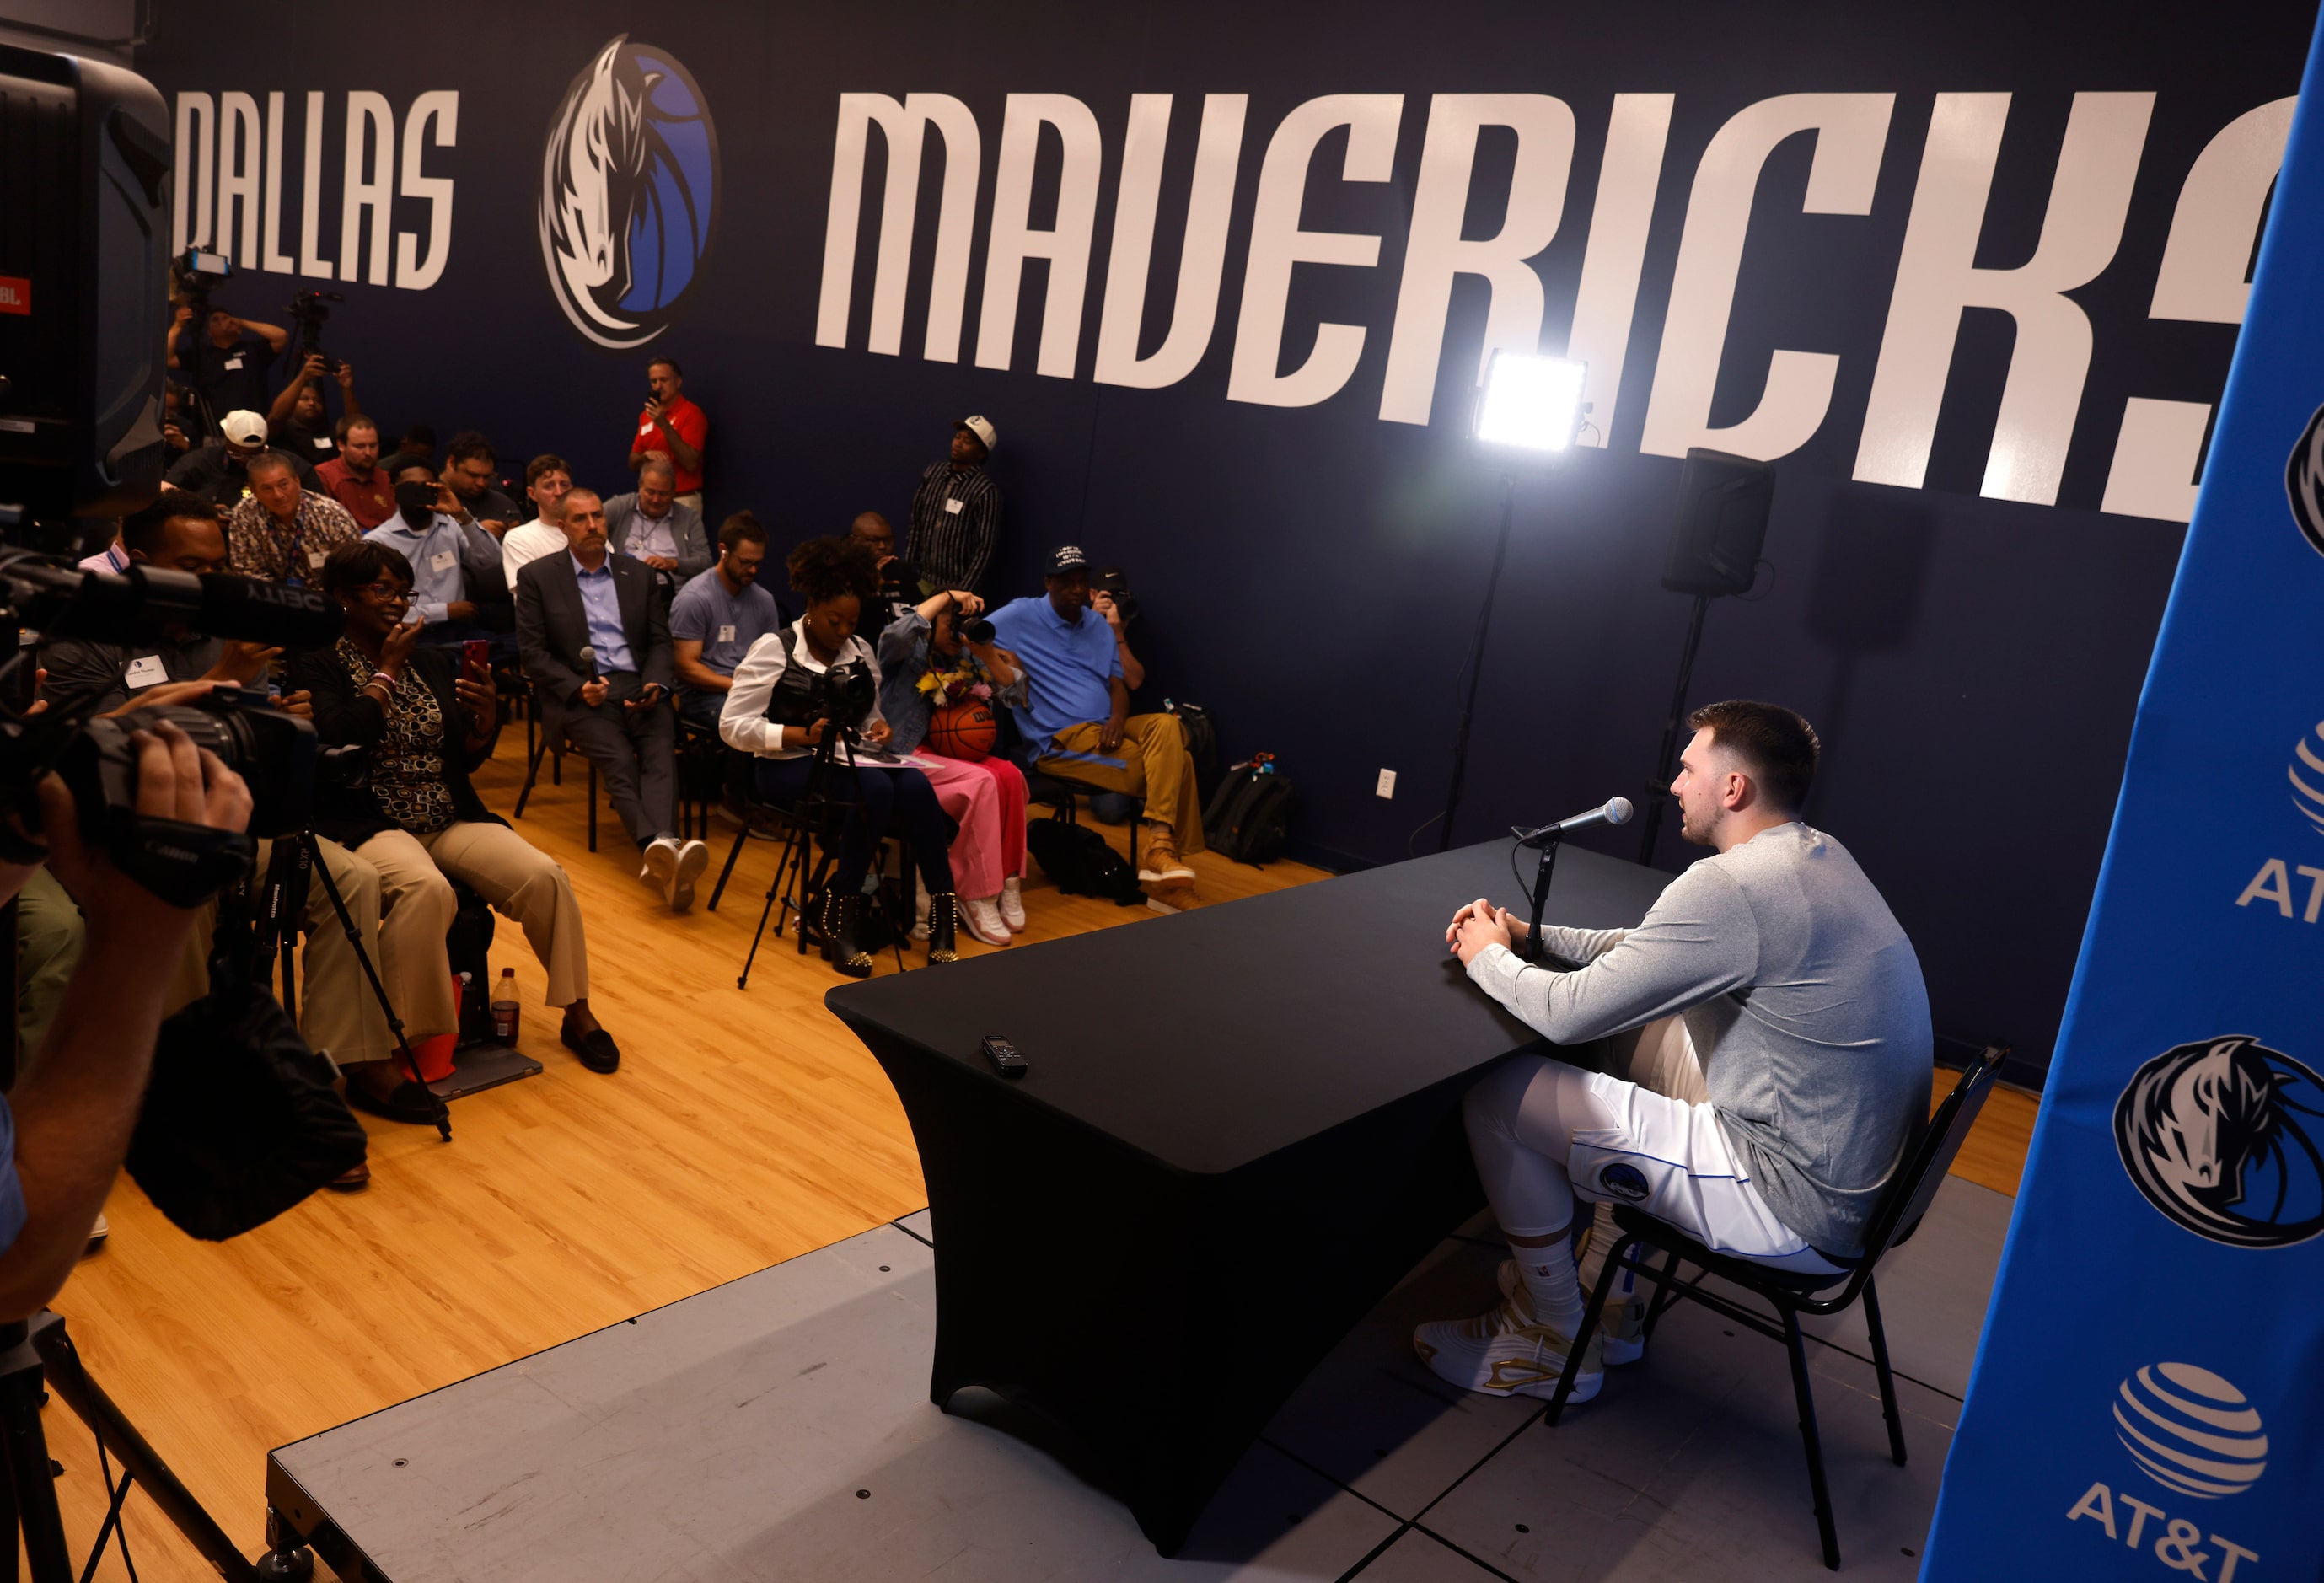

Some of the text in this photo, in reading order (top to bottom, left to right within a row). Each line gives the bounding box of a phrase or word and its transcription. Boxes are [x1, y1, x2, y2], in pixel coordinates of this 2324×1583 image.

[172, 89, 2300, 523] DALLAS MAVERICKS
[246, 582, 325, 613] DEITY
[270, 883, 281, 919] Manfrotto
[2066, 1482, 2260, 1583] AT&T
